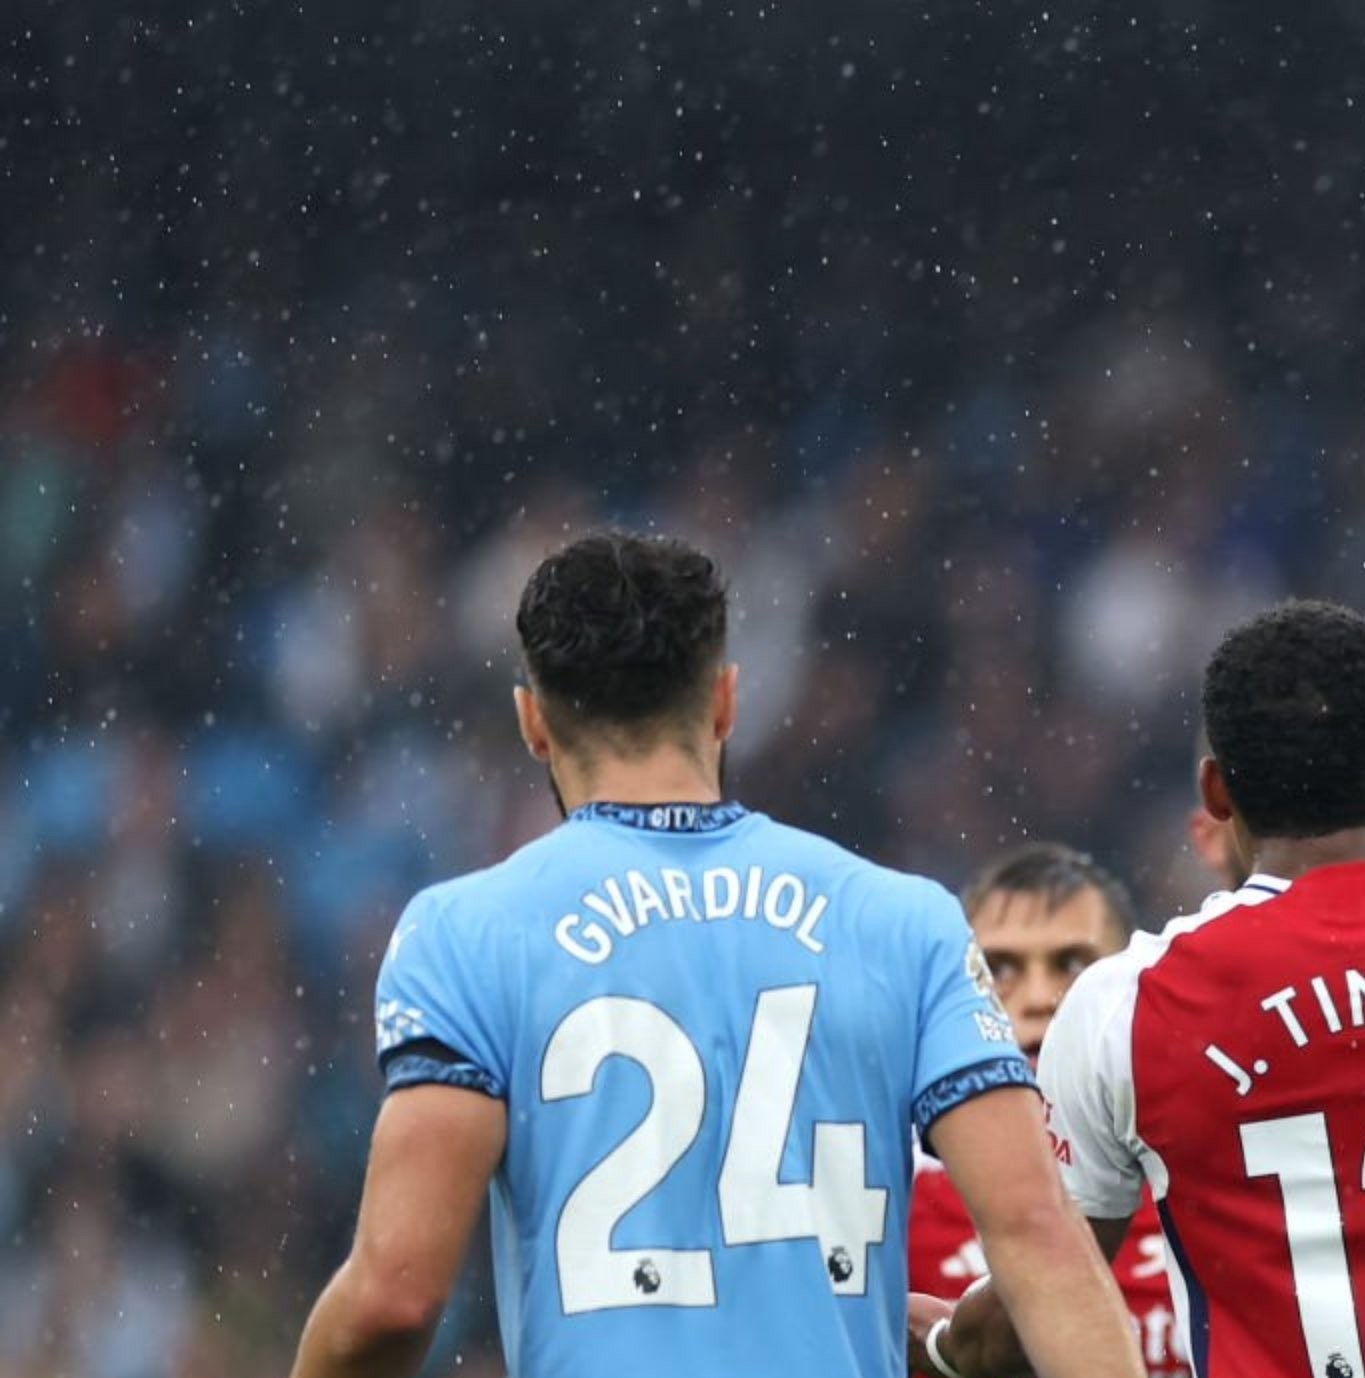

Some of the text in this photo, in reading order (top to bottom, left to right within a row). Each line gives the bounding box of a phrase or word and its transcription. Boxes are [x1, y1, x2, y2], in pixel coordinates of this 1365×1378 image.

[651, 807, 698, 828] CITY
[555, 866, 830, 964] GVARDIOL
[1205, 1044, 1269, 1096] J.
[539, 983, 888, 1315] 24
